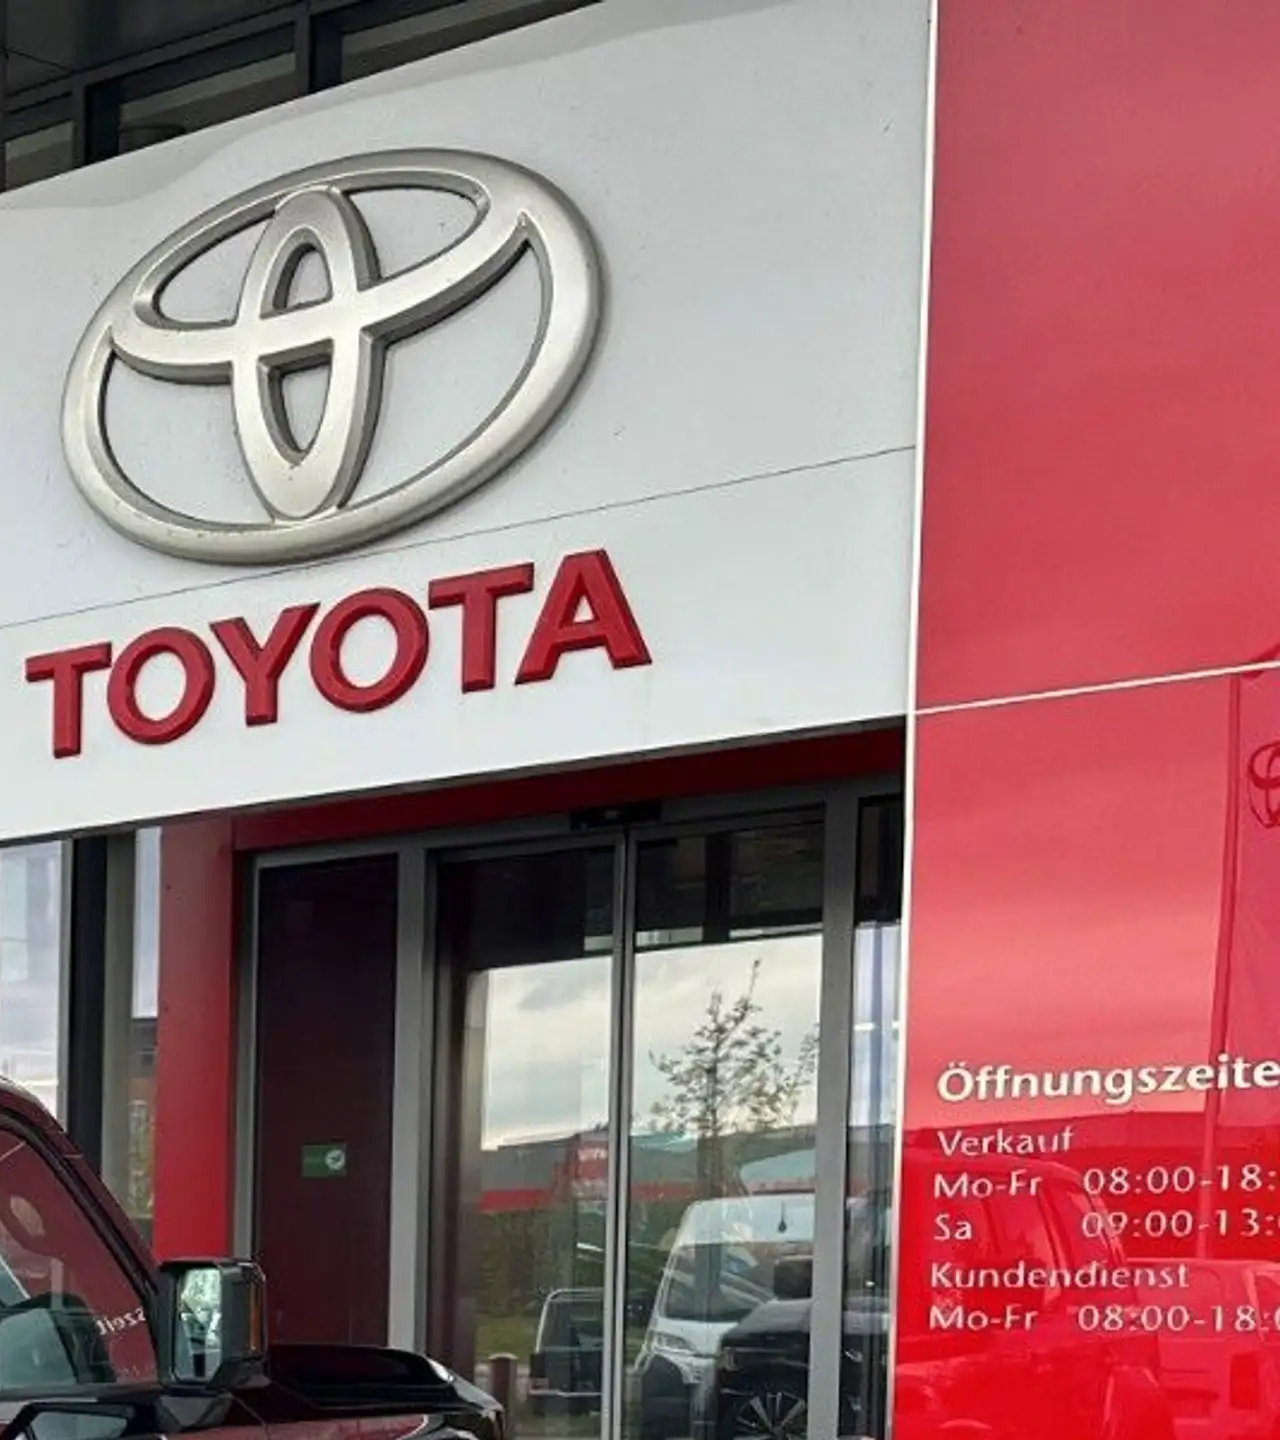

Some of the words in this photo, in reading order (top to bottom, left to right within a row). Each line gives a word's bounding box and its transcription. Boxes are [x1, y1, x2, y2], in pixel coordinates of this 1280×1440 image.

[25, 548, 653, 758] TOYOTA
[938, 1126, 1074, 1156] Verkauf
[934, 1169, 1043, 1198] Mo-Fr
[934, 1215, 972, 1241] Sa
[1081, 1209, 1280, 1239] 09:00-13:
[931, 1260, 1189, 1288] Kundendienst
[929, 1305, 1039, 1331] Mo-Fr
